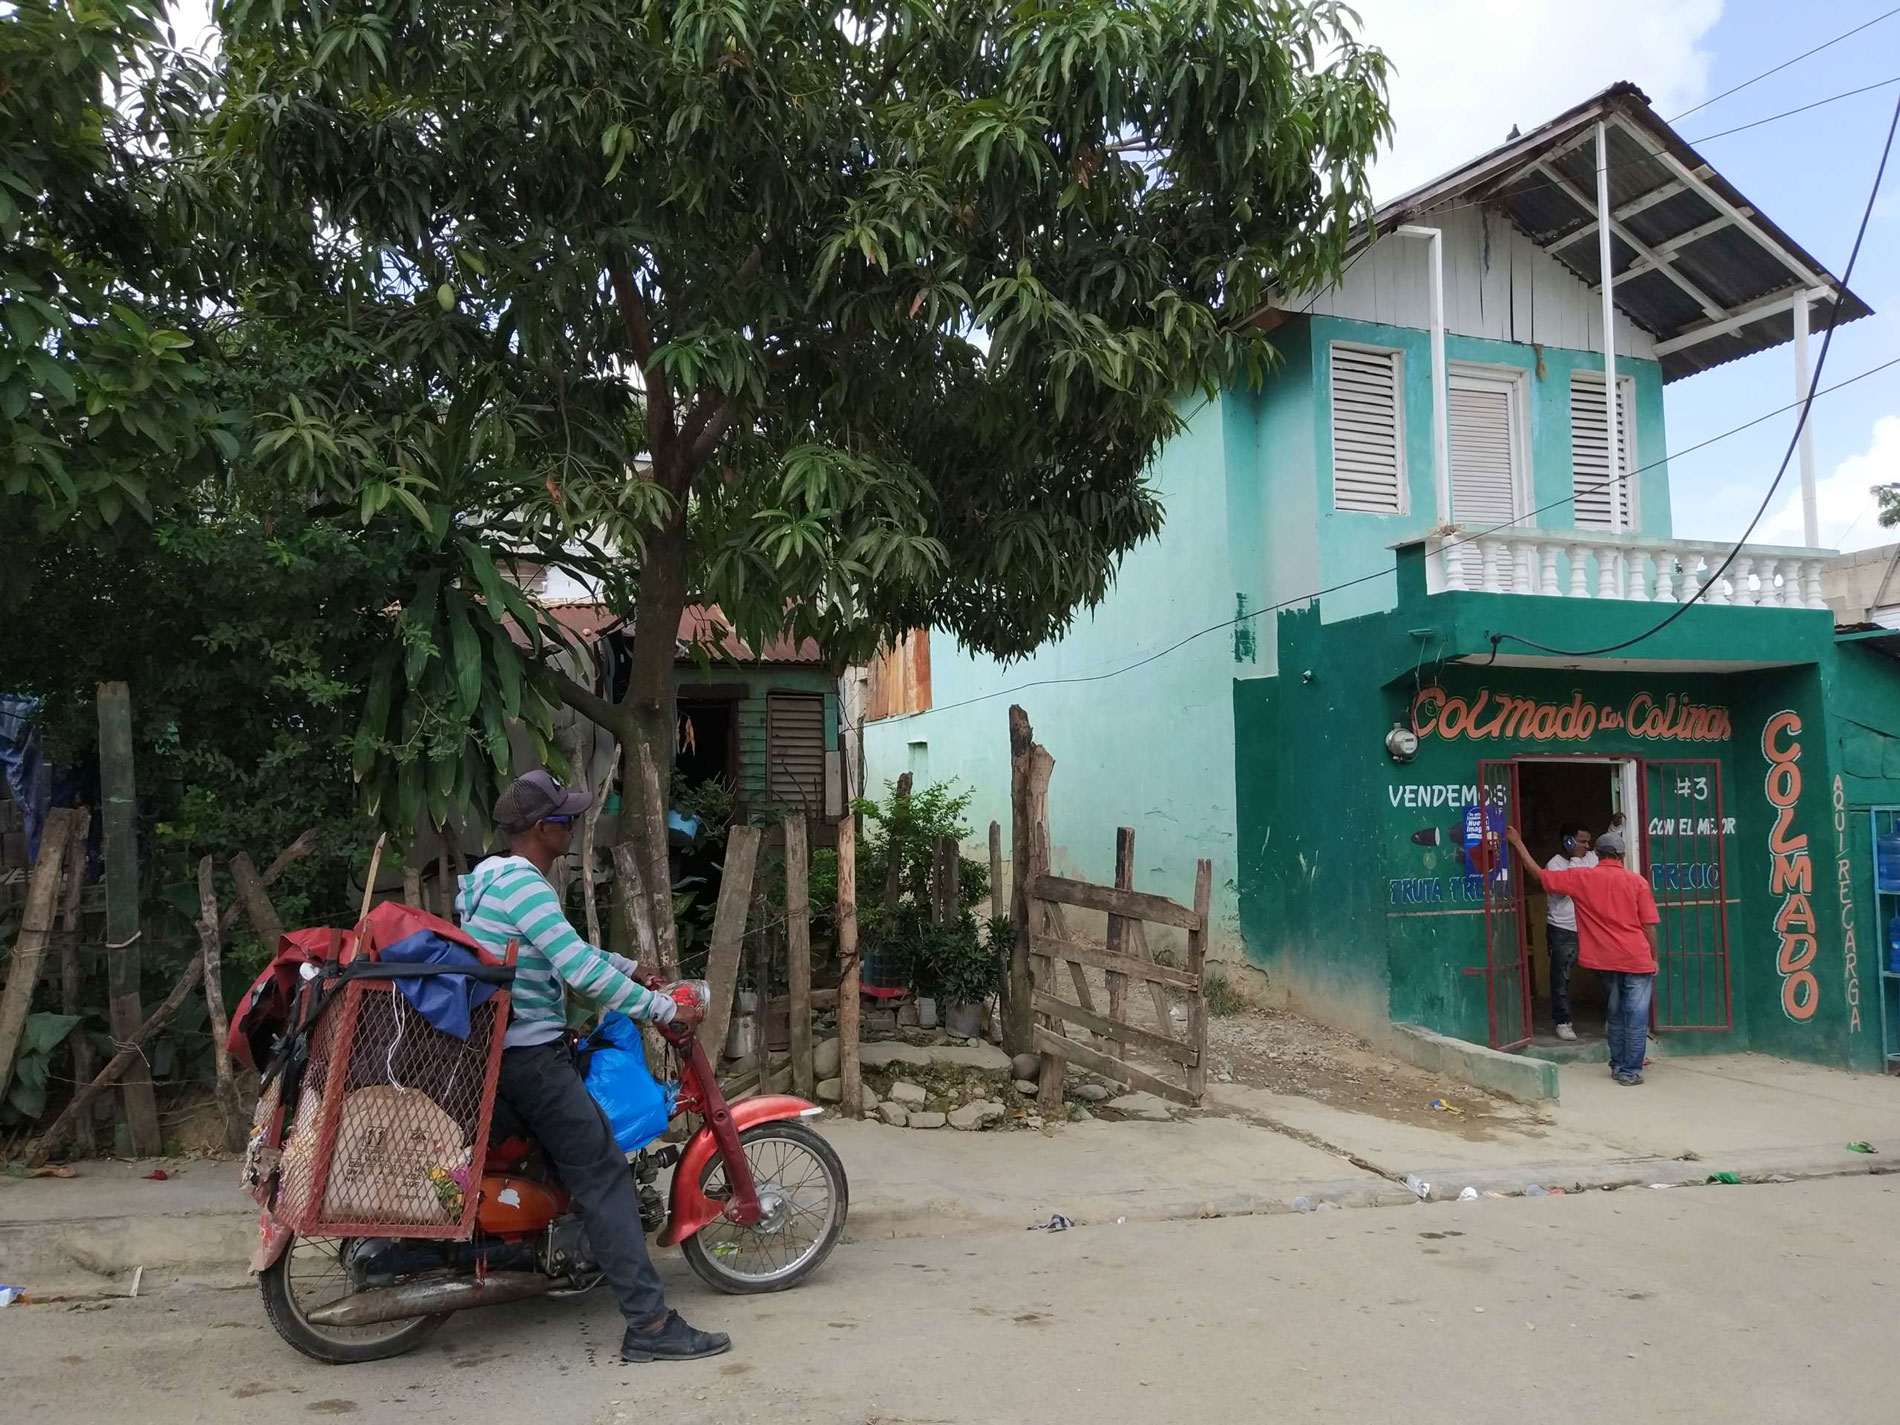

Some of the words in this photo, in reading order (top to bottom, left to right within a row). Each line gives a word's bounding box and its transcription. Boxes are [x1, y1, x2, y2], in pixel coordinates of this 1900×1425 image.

[1388, 784, 1507, 807] VENDEMOS
[1674, 777, 1708, 800] #3
[1679, 818, 1695, 835] EL
[1697, 817, 1736, 835] MEOR
[1650, 863, 1720, 890] PRECIO
[1761, 709, 1820, 1024] COLMADO
[1389, 877, 1442, 904] FRUTA
